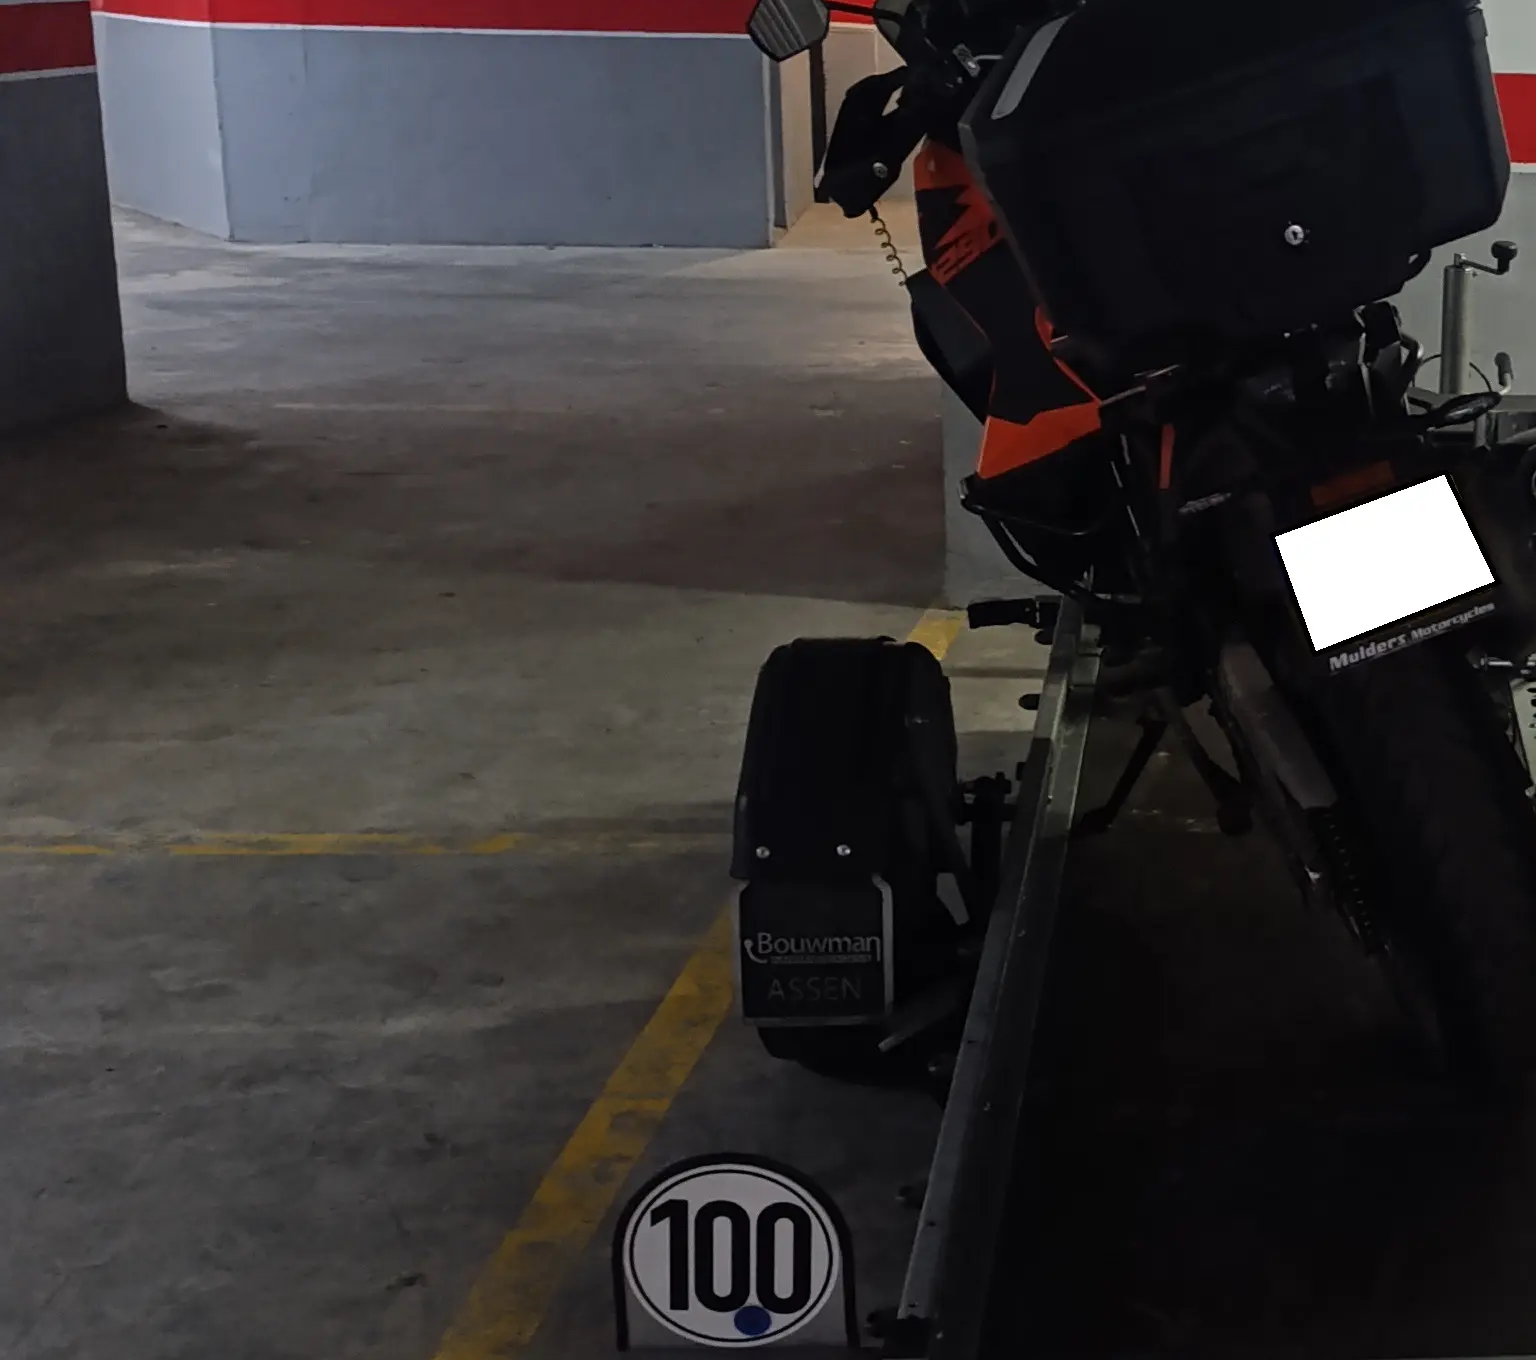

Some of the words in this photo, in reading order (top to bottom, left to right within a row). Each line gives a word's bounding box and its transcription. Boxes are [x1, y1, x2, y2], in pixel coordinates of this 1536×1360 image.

[1328, 633, 1407, 671] Mulders
[1409, 602, 1496, 641] Motorcycles
[756, 931, 882, 963] Bouwman
[767, 976, 862, 1001] ASSEN
[650, 1198, 812, 1315] 100
